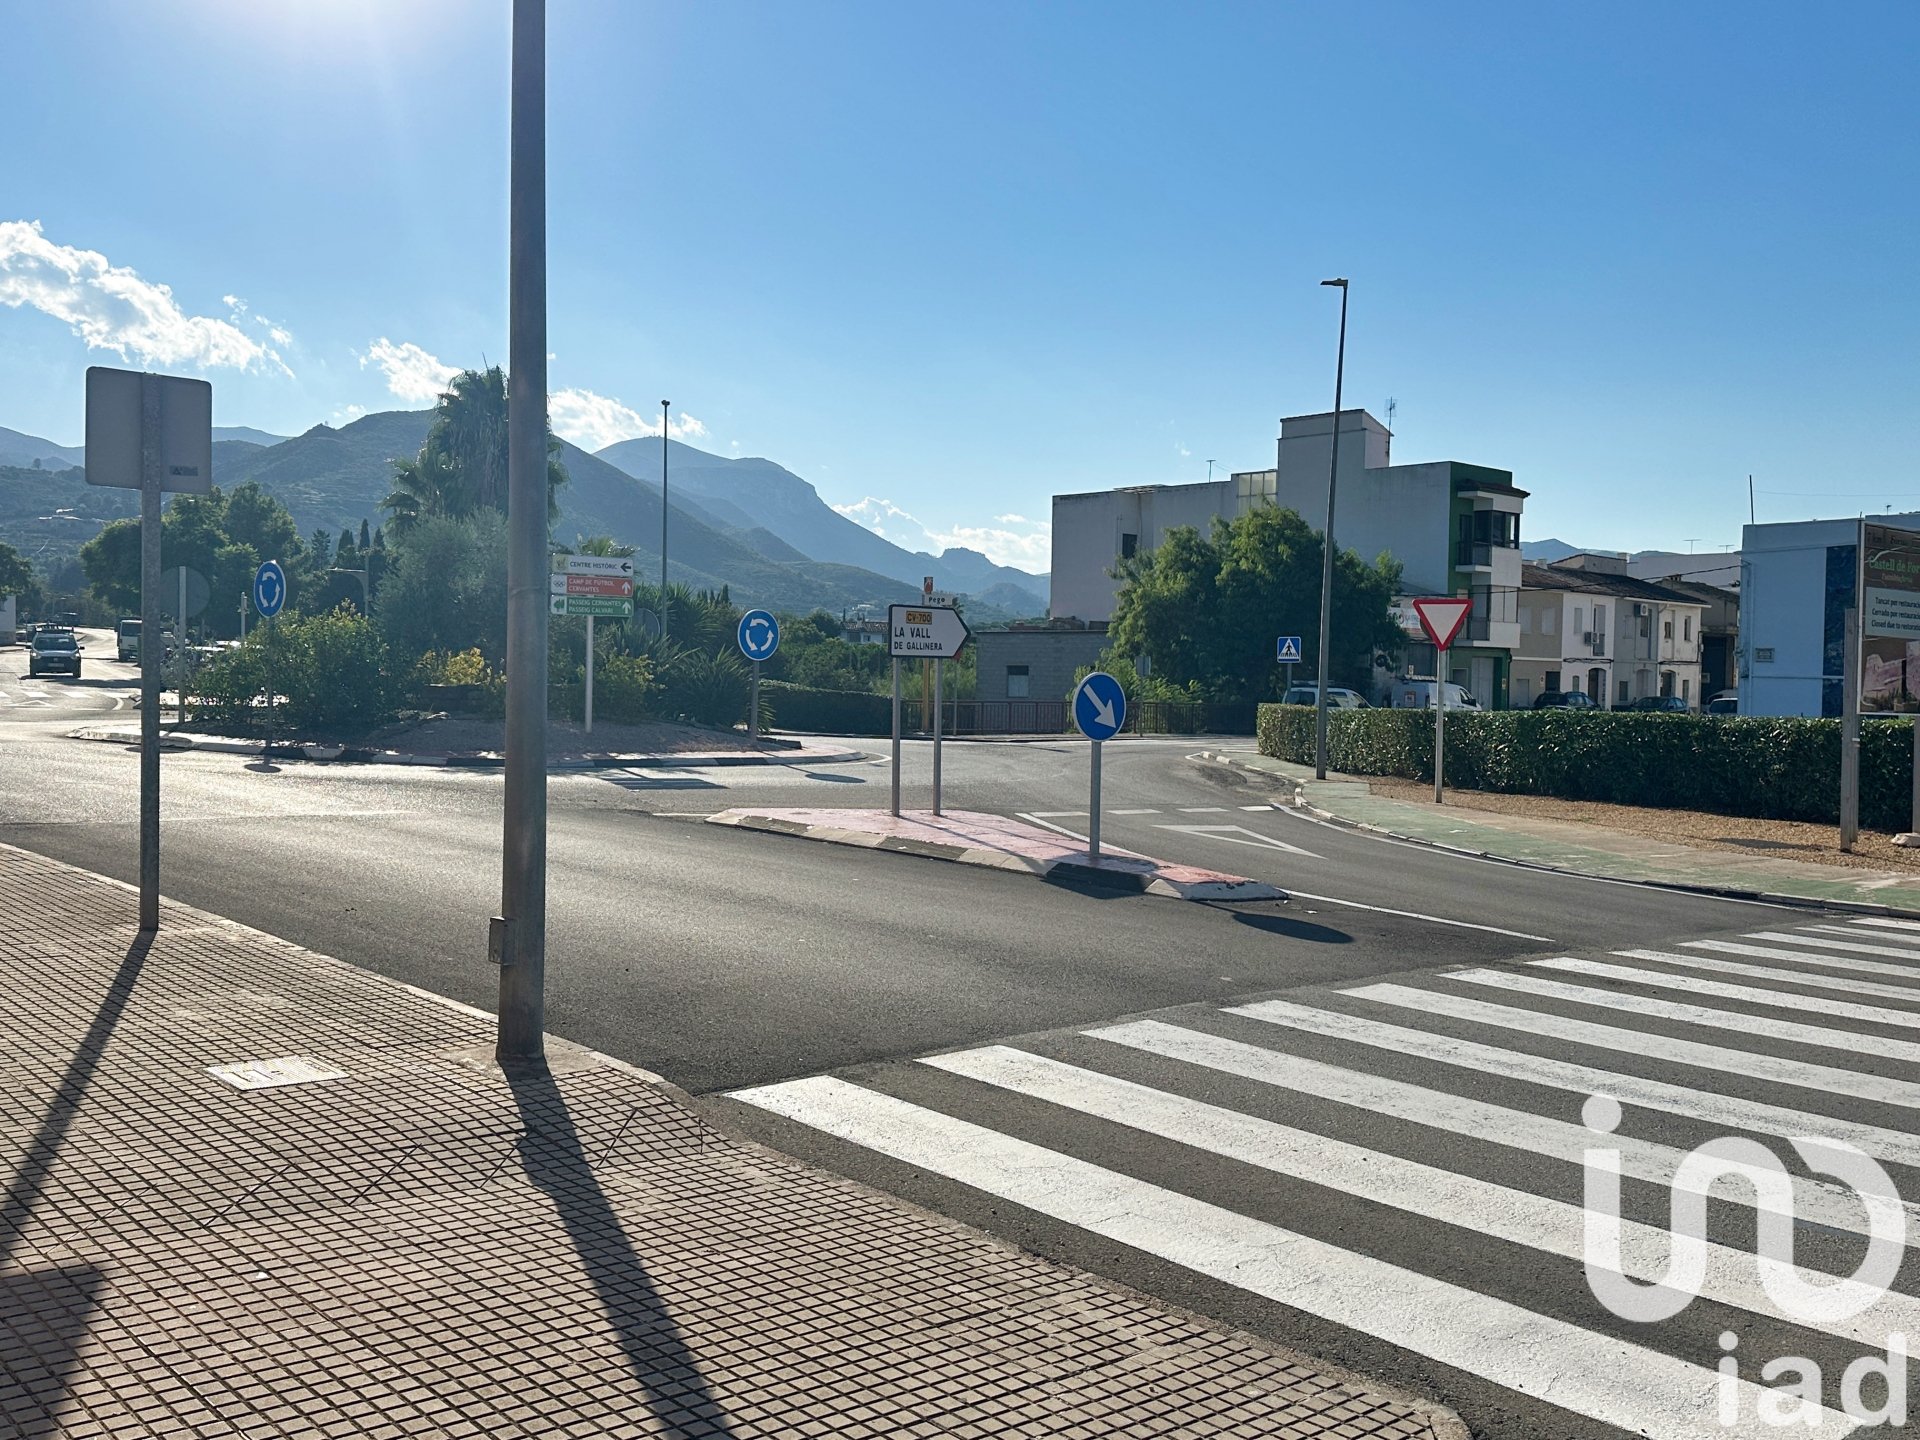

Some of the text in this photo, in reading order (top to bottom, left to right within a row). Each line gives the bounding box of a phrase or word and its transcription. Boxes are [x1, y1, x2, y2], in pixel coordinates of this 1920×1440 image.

[569, 561, 591, 569] CENTRE
[1869, 556, 1895, 571] Castell
[1896, 559, 1906, 572] de
[928, 596, 946, 604] Pego
[1875, 597, 1890, 605] Tancat
[1871, 607, 1889, 617] Cerrado
[907, 613, 931, 623] CV-700
[1871, 620, 1887, 628] Closed
[894, 627, 931, 639] LA VALL
[894, 641, 943, 651] DE GALLINERA
